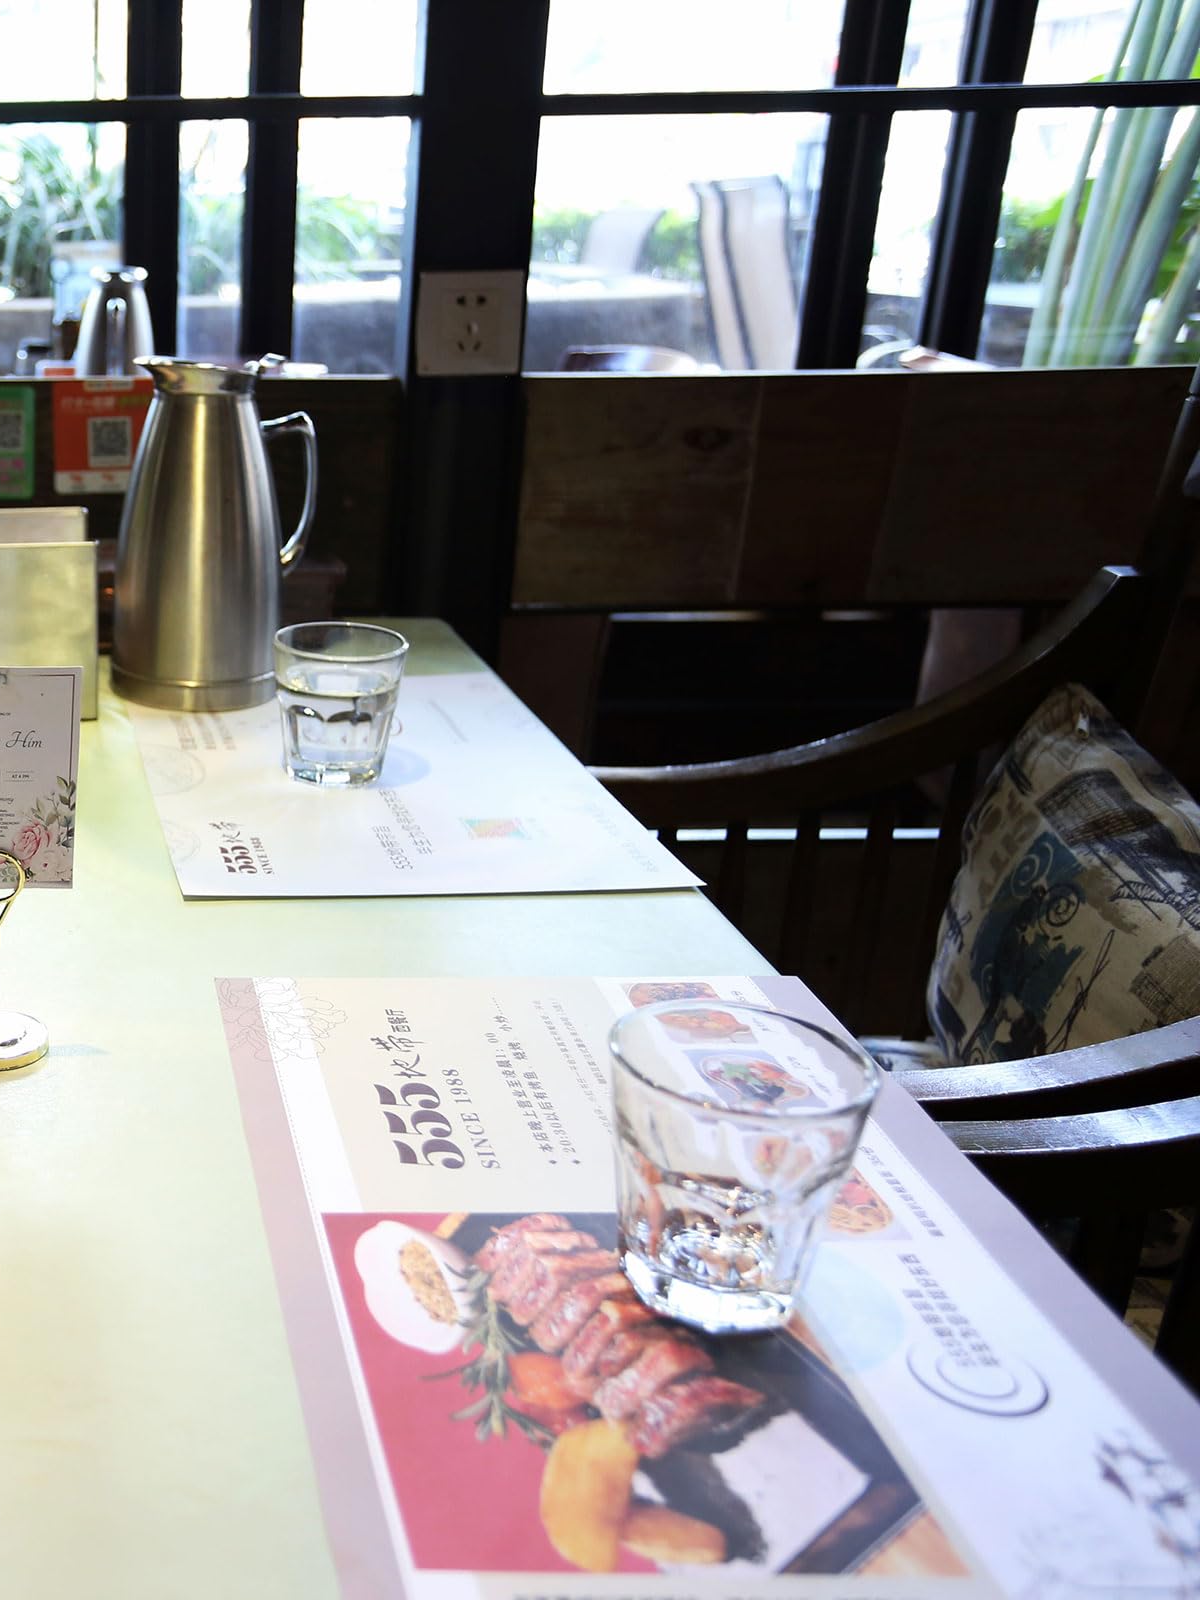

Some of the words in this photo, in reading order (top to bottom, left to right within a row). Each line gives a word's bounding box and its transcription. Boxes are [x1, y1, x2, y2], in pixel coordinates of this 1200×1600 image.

[5, 730, 42, 748] Him
[218, 845, 258, 874] 555
[442, 1068, 473, 1105] 1988
[373, 1082, 466, 1170] 555
[460, 1112, 502, 1170] SINCE
